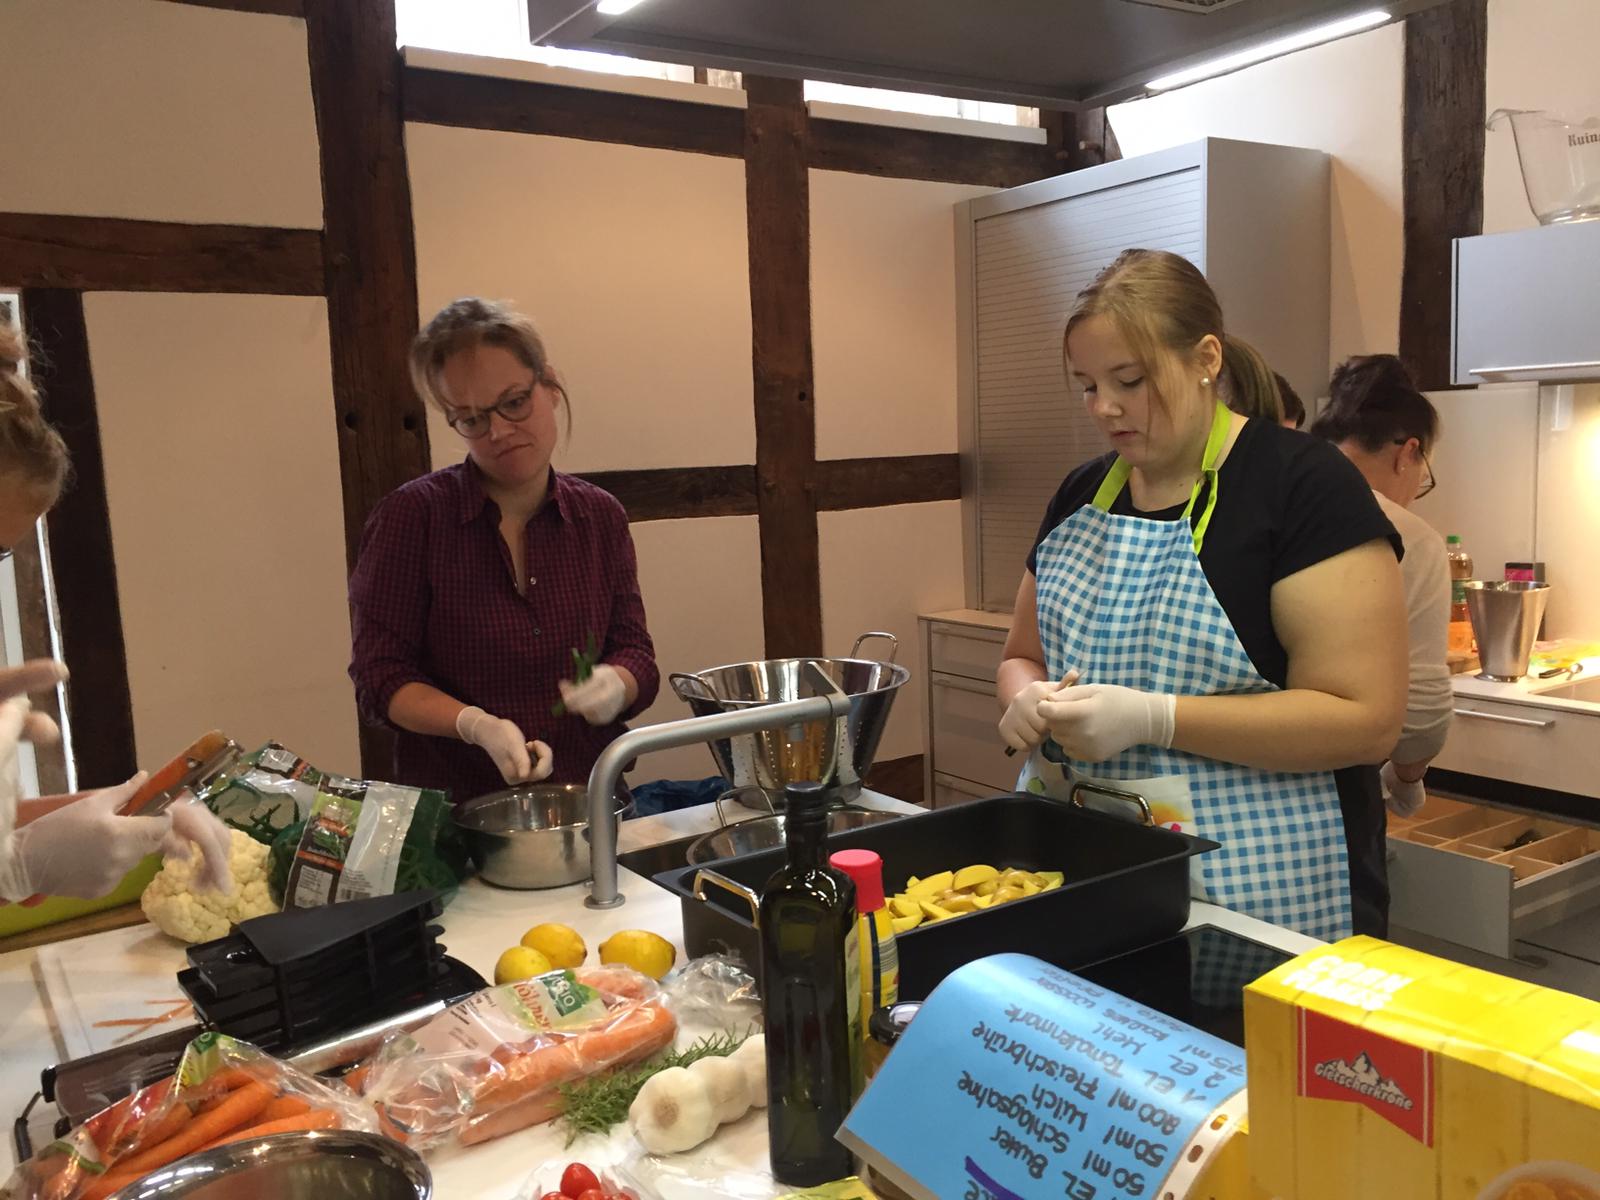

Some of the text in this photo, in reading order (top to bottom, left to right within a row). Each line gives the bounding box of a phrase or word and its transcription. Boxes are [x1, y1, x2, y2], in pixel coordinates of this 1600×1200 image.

[972, 1020, 1100, 1100] Fleischbrühe
[1092, 1022, 1147, 1056] Mehl
[1031, 1083, 1089, 1132] Milch
[1314, 1062, 1414, 1111] Gletscherkrone
[957, 1070, 1070, 1154] Schlagsahne
